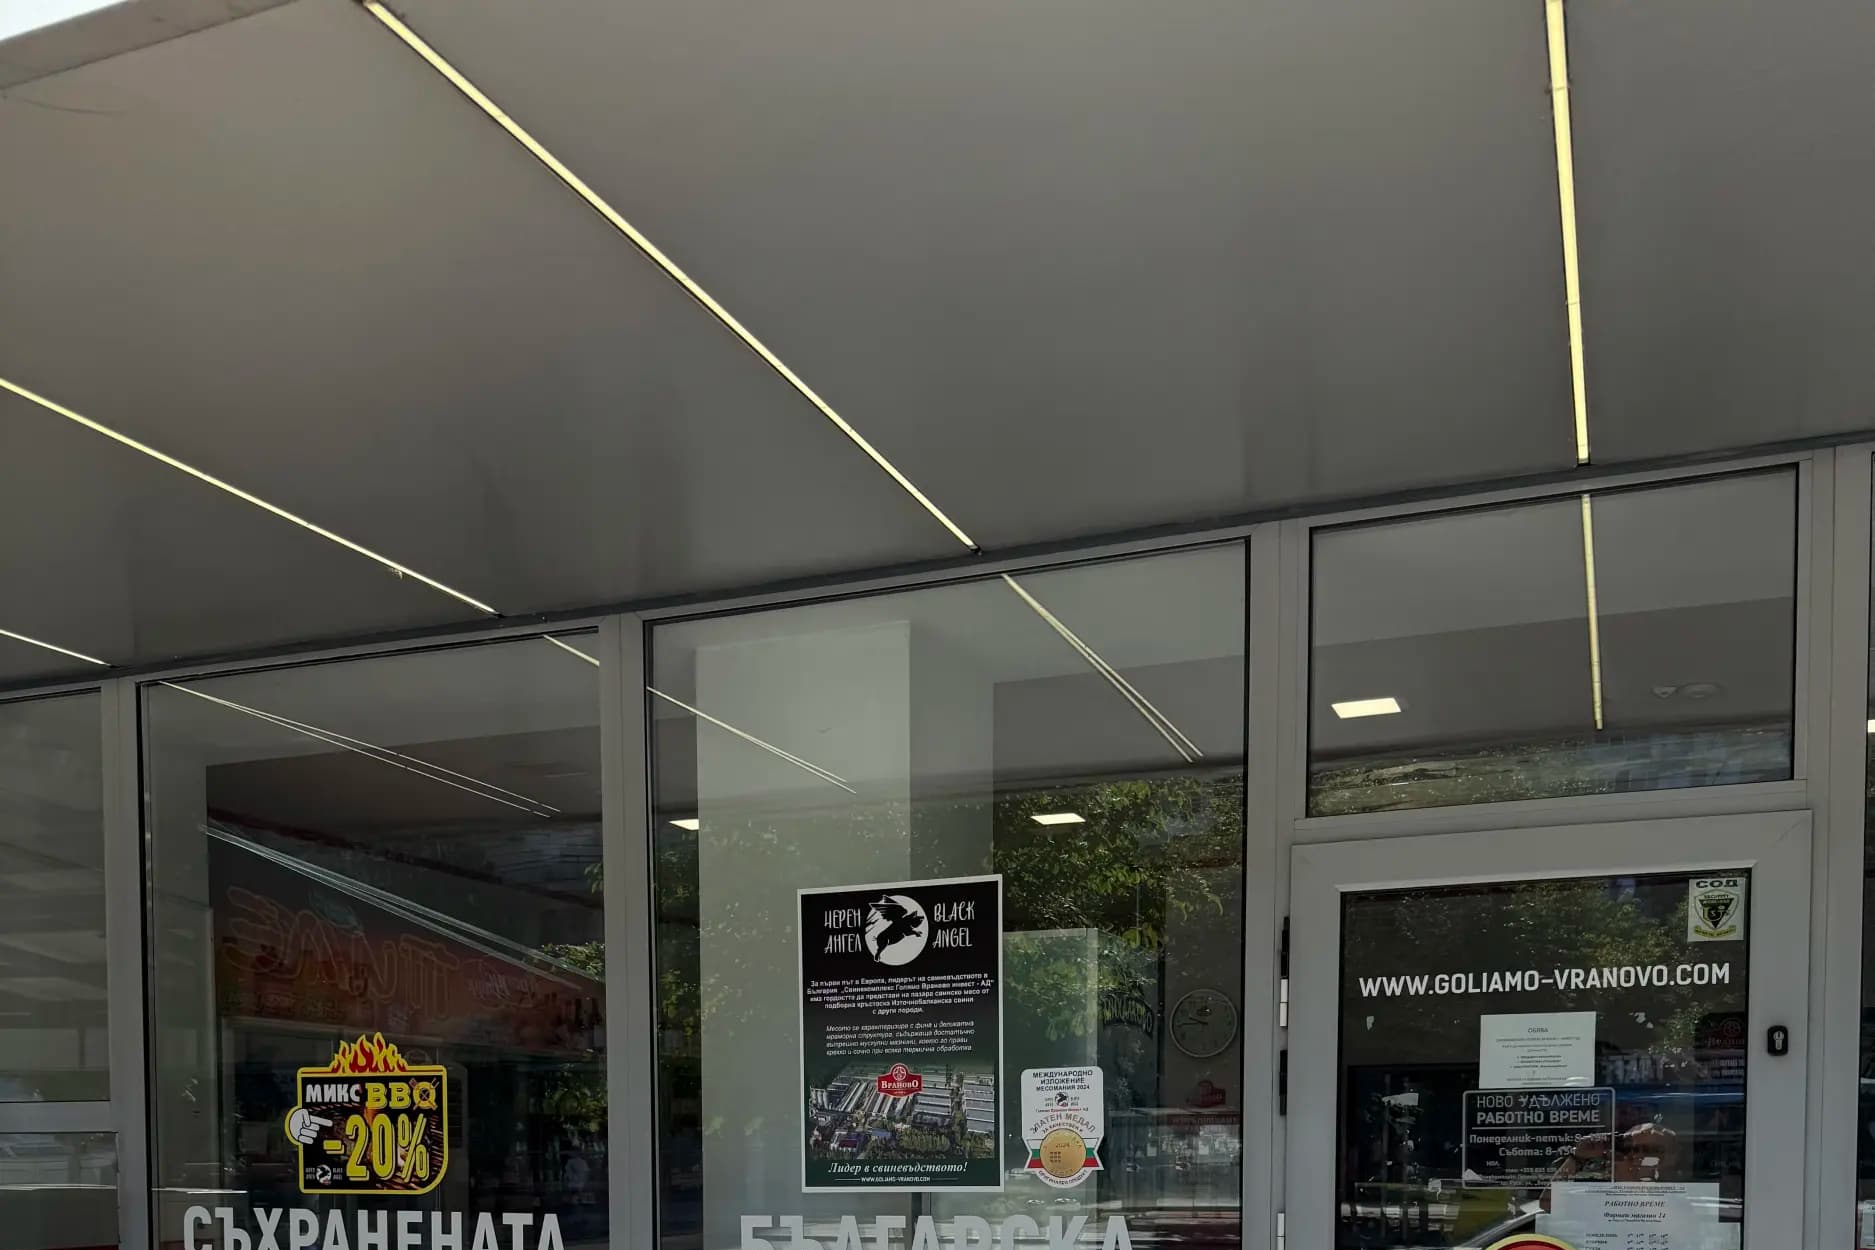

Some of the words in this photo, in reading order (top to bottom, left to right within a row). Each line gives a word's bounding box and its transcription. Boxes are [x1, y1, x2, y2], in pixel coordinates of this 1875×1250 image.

[1696, 879, 1738, 889] СОД
[824, 908, 861, 929] ЧЕРЕН
[934, 900, 975, 922] BLACK
[824, 933, 862, 954] АНГЕЛ
[932, 927, 973, 948] ANGEL
[1359, 962, 1731, 997] WWW.GOLIAMO-VRANOVO.COM
[1032, 1070, 1093, 1079] МЕЖДУНАРОДНО
[1040, 1077, 1085, 1085] ИЗЛОЖЕНИЕ
[305, 1083, 361, 1103] МИКС
[1477, 1095, 1513, 1109] НОВО
[1519, 1094, 1600, 1109] УДЪЛЖЕНО
[1477, 1111, 1544, 1124] РАБОТНО
[1550, 1110, 1600, 1123] ВРЕМЕ
[323, 1113, 429, 1182] -20%
[1499, 1147, 1543, 1157] Събота:
[828, 1162, 861, 1175] Лидер
[864, 1164, 870, 1172] в
[872, 1161, 968, 1173] свиневъдството!
